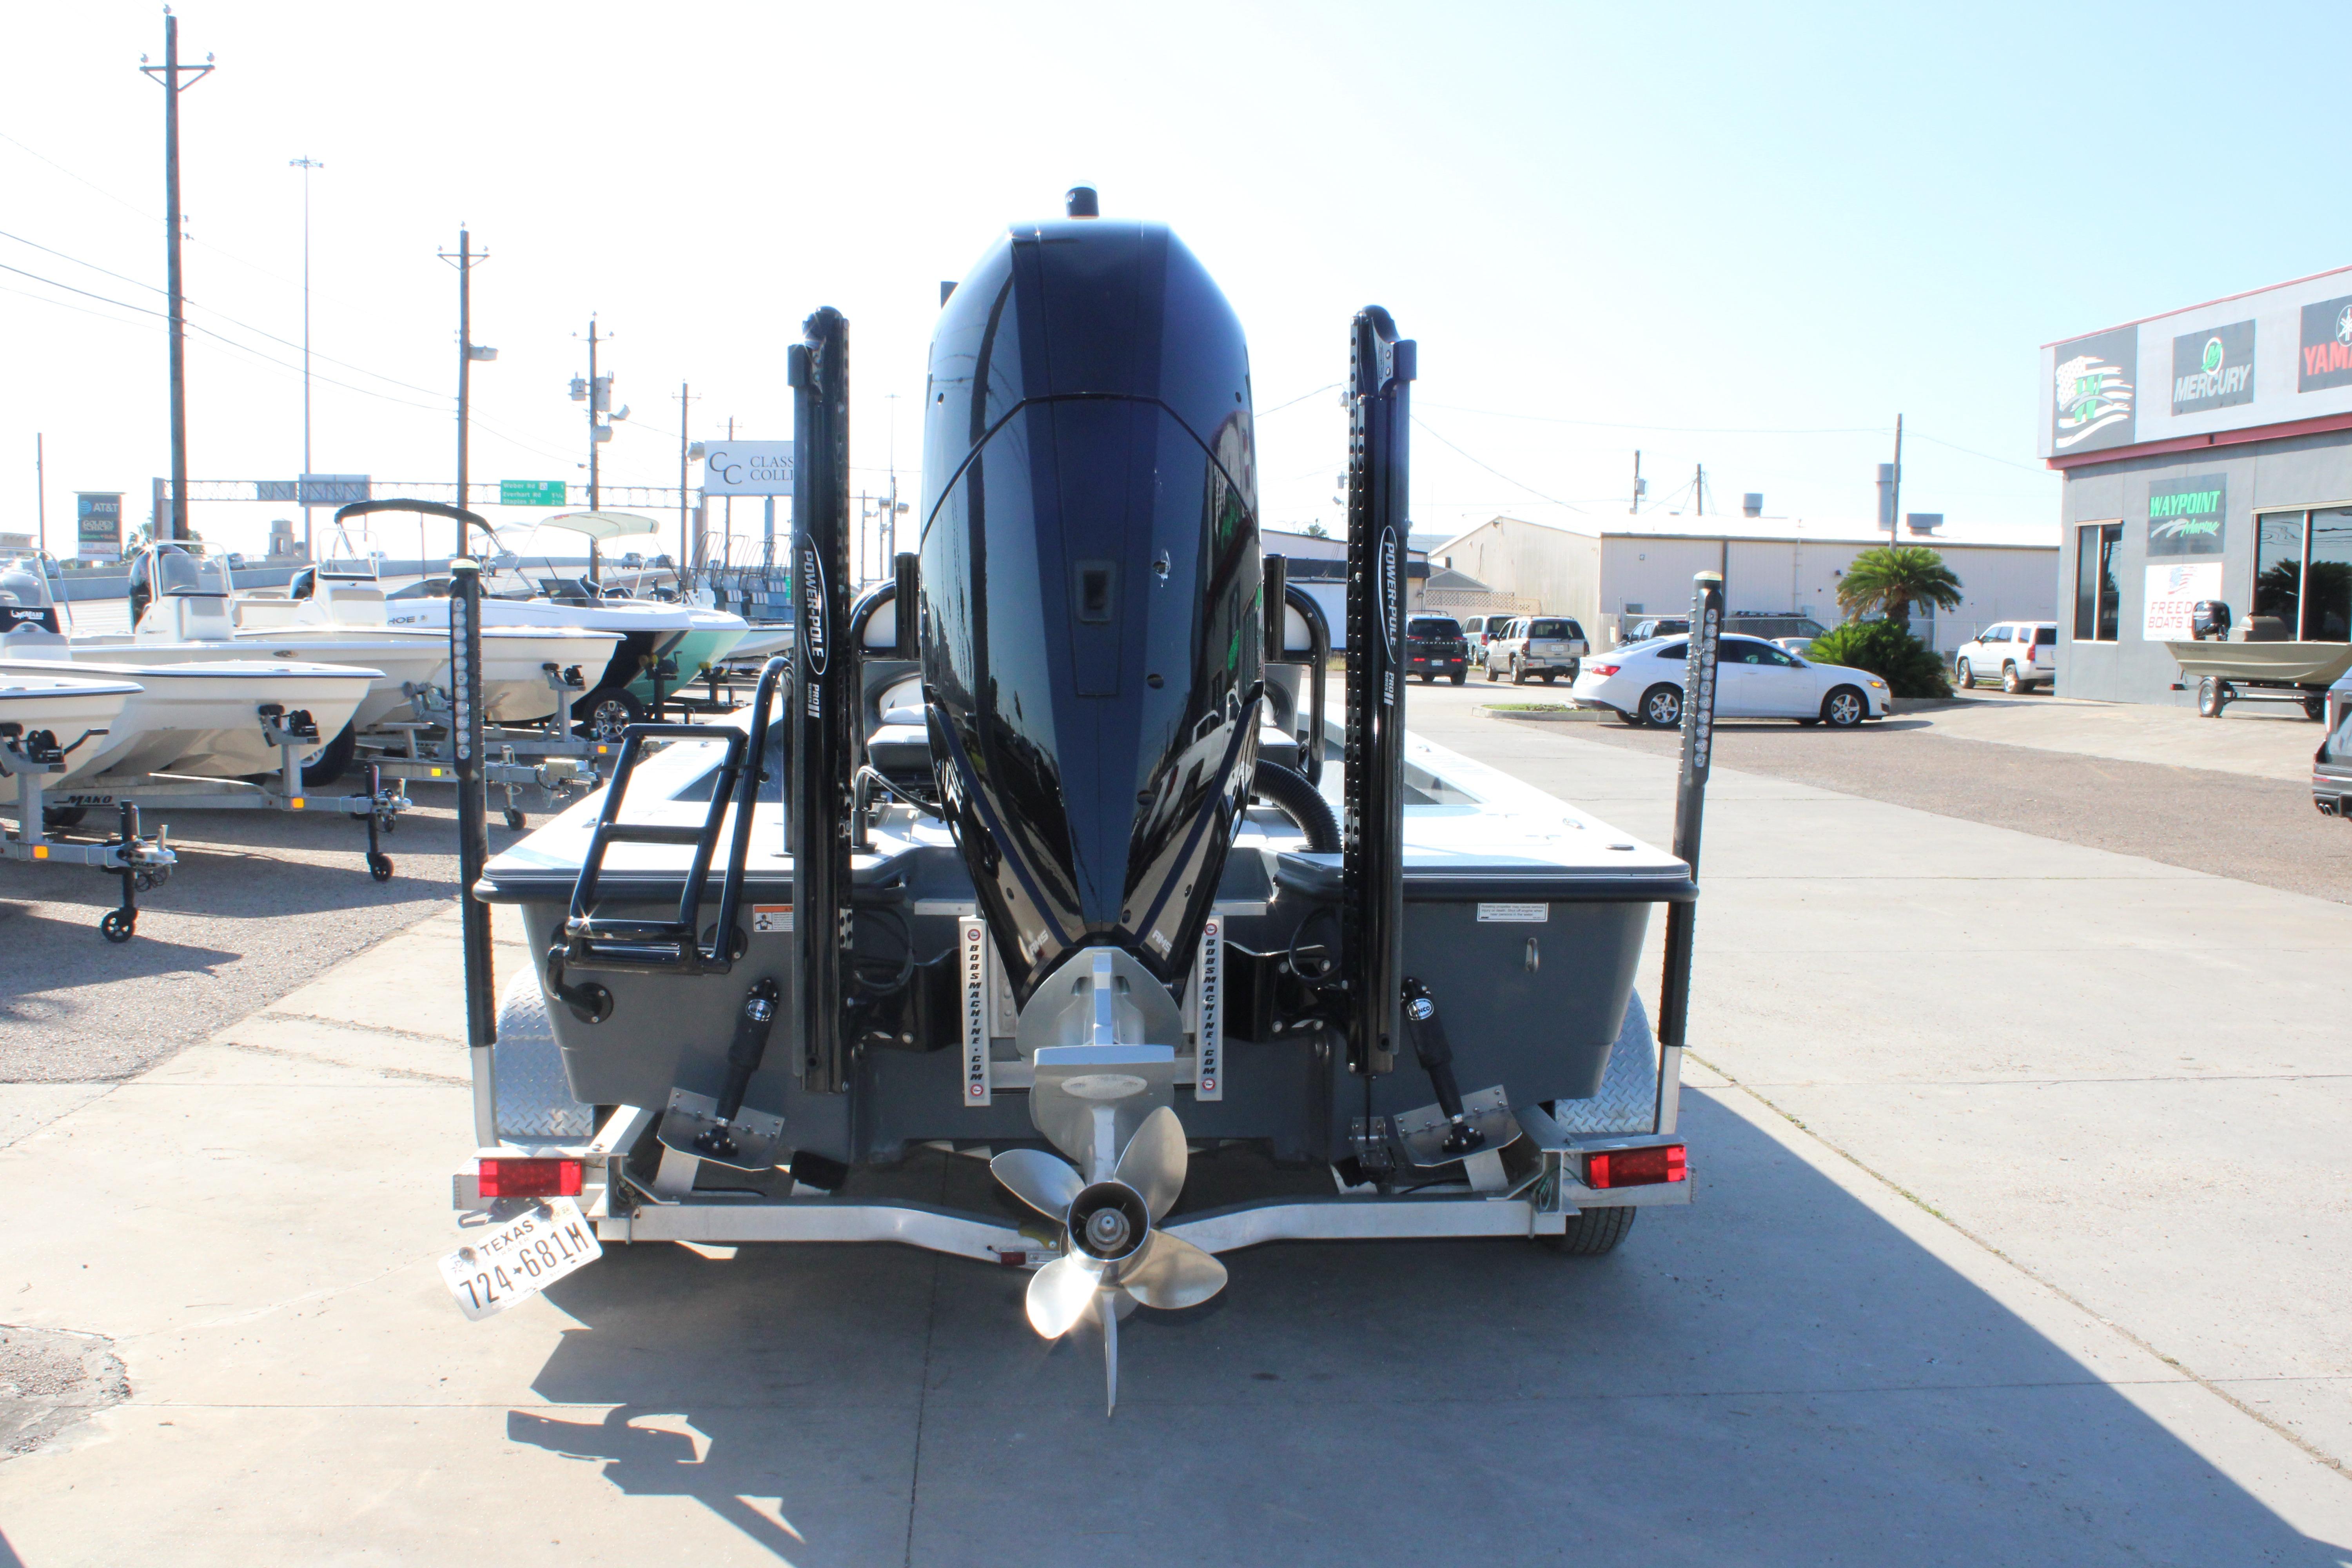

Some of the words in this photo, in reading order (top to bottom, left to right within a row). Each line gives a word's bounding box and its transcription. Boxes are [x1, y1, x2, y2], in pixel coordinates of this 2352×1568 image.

[2304, 341, 2352, 376] YAM
[2173, 364, 2251, 403] MERCURY
[93, 503, 119, 512] AT&T
[2150, 491, 2220, 517] WAYPOINT
[2180, 519, 2220, 537] Marine
[804, 550, 824, 658] POWER-POLE
[1385, 541, 1397, 646] POWER-POLE
[2151, 601, 2194, 614] FREED
[2148, 617, 2183, 628] BOATS
[67, 795, 114, 807] MAKO
[1029, 929, 1049, 955] AMS
[1152, 930, 1172, 953] AMS
[480, 1219, 535, 1256] TEXAS
